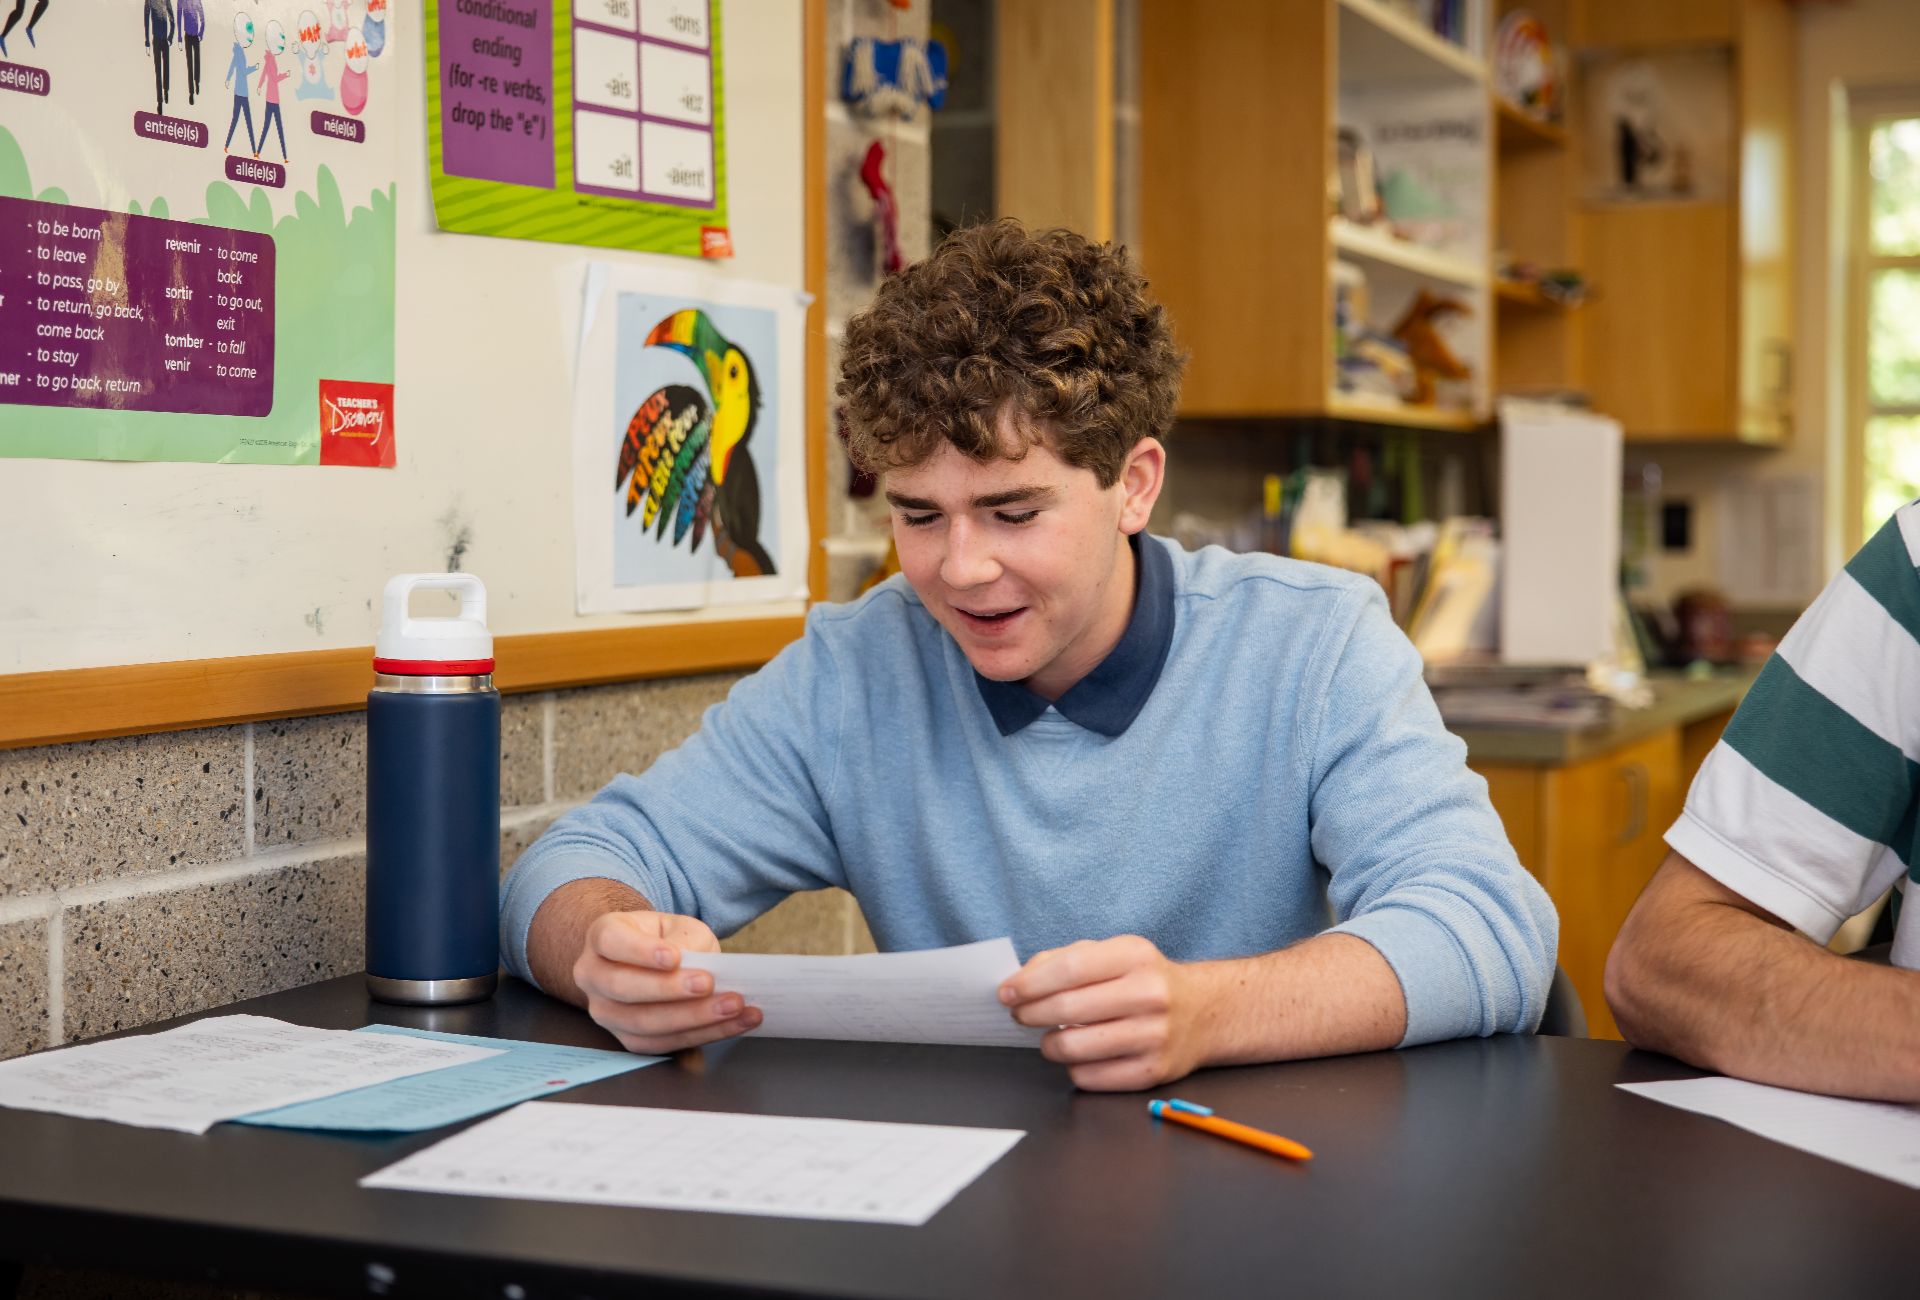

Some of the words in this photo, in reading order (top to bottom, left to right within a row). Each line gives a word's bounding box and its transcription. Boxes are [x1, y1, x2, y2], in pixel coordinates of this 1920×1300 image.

[472, 36, 522, 68] ending
[449, 62, 475, 88] (for
[478, 76, 498, 94] -re
[503, 78, 546, 106] verbs,
[324, 117, 357, 138] né(e)(s)
[452, 101, 486, 132] drop
[490, 108, 513, 132] the
[144, 120, 199, 143] entré(e)(s)
[235, 161, 277, 184] allé(e)(s)
[37, 220, 50, 234] to
[53, 220, 70, 236] be
[72, 223, 102, 241] born
[37, 246, 50, 260] to
[53, 246, 87, 263] leave
[165, 238, 201, 254] revenir
[217, 246, 228, 259] to
[230, 250, 258, 264] come
[37, 271, 50, 285] to
[53, 273, 84, 291] pass,
[87, 279, 103, 293] go
[105, 279, 120, 296] by
[217, 269, 243, 285] back
[37, 297, 50, 311] to
[53, 299, 93, 318] return,
[96, 306, 112, 319] go
[114, 304, 144, 322] back,
[165, 285, 194, 301] sortir
[217, 294, 228, 307] to
[229, 297, 243, 311] go
[244, 297, 263, 313] out,
[37, 324, 72, 339] come
[75, 323, 105, 341] back
[216, 316, 236, 331] exit
[165, 333, 204, 349] tomber
[217, 340, 228, 353] to
[229, 340, 247, 355] fall
[37, 347, 50, 362] to
[52, 348, 79, 367] stay
[165, 357, 191, 372] venir
[216, 364, 227, 376] to
[229, 366, 257, 379] come
[36, 373, 49, 387] to
[52, 377, 69, 392] go
[71, 375, 103, 393] back,
[105, 377, 142, 393] return
[336, 397, 379, 409] TEACHER'S
[324, 399, 385, 446] Discovery
